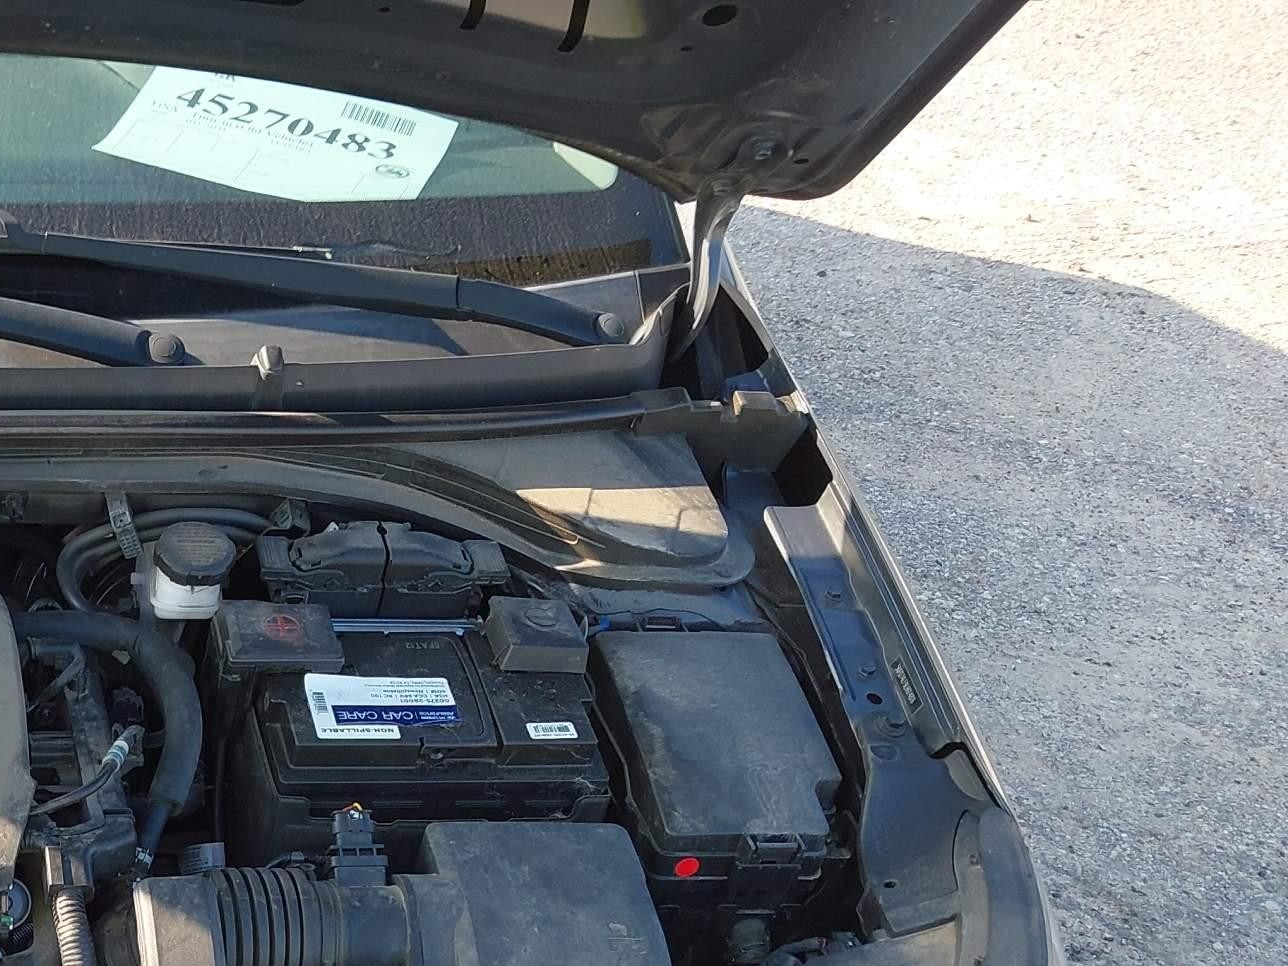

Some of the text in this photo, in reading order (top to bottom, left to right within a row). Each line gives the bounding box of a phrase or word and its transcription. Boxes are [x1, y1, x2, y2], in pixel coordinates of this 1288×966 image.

[176, 87, 398, 160] 45270483
[338, 710, 414, 721] CAR CARE
